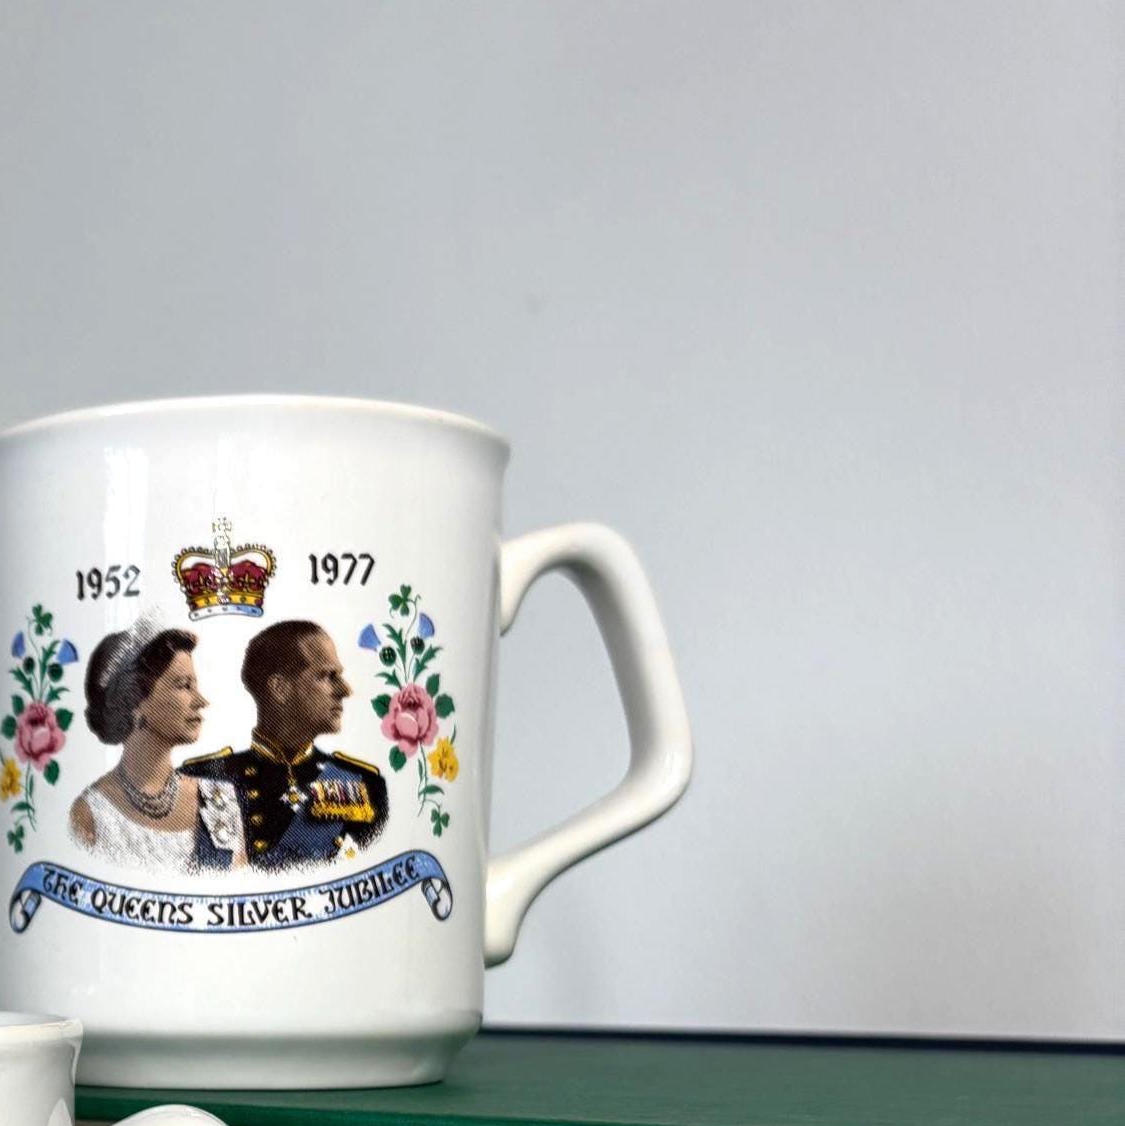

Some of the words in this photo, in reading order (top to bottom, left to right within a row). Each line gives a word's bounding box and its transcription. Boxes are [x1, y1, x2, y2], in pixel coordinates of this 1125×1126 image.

[76, 564, 141, 601] 1952
[308, 552, 376, 586] 1977
[43, 868, 84, 905] THE
[90, 887, 194, 926] QUEENS
[207, 900, 313, 927] SILVER
[318, 856, 420, 914] JUBILEE
